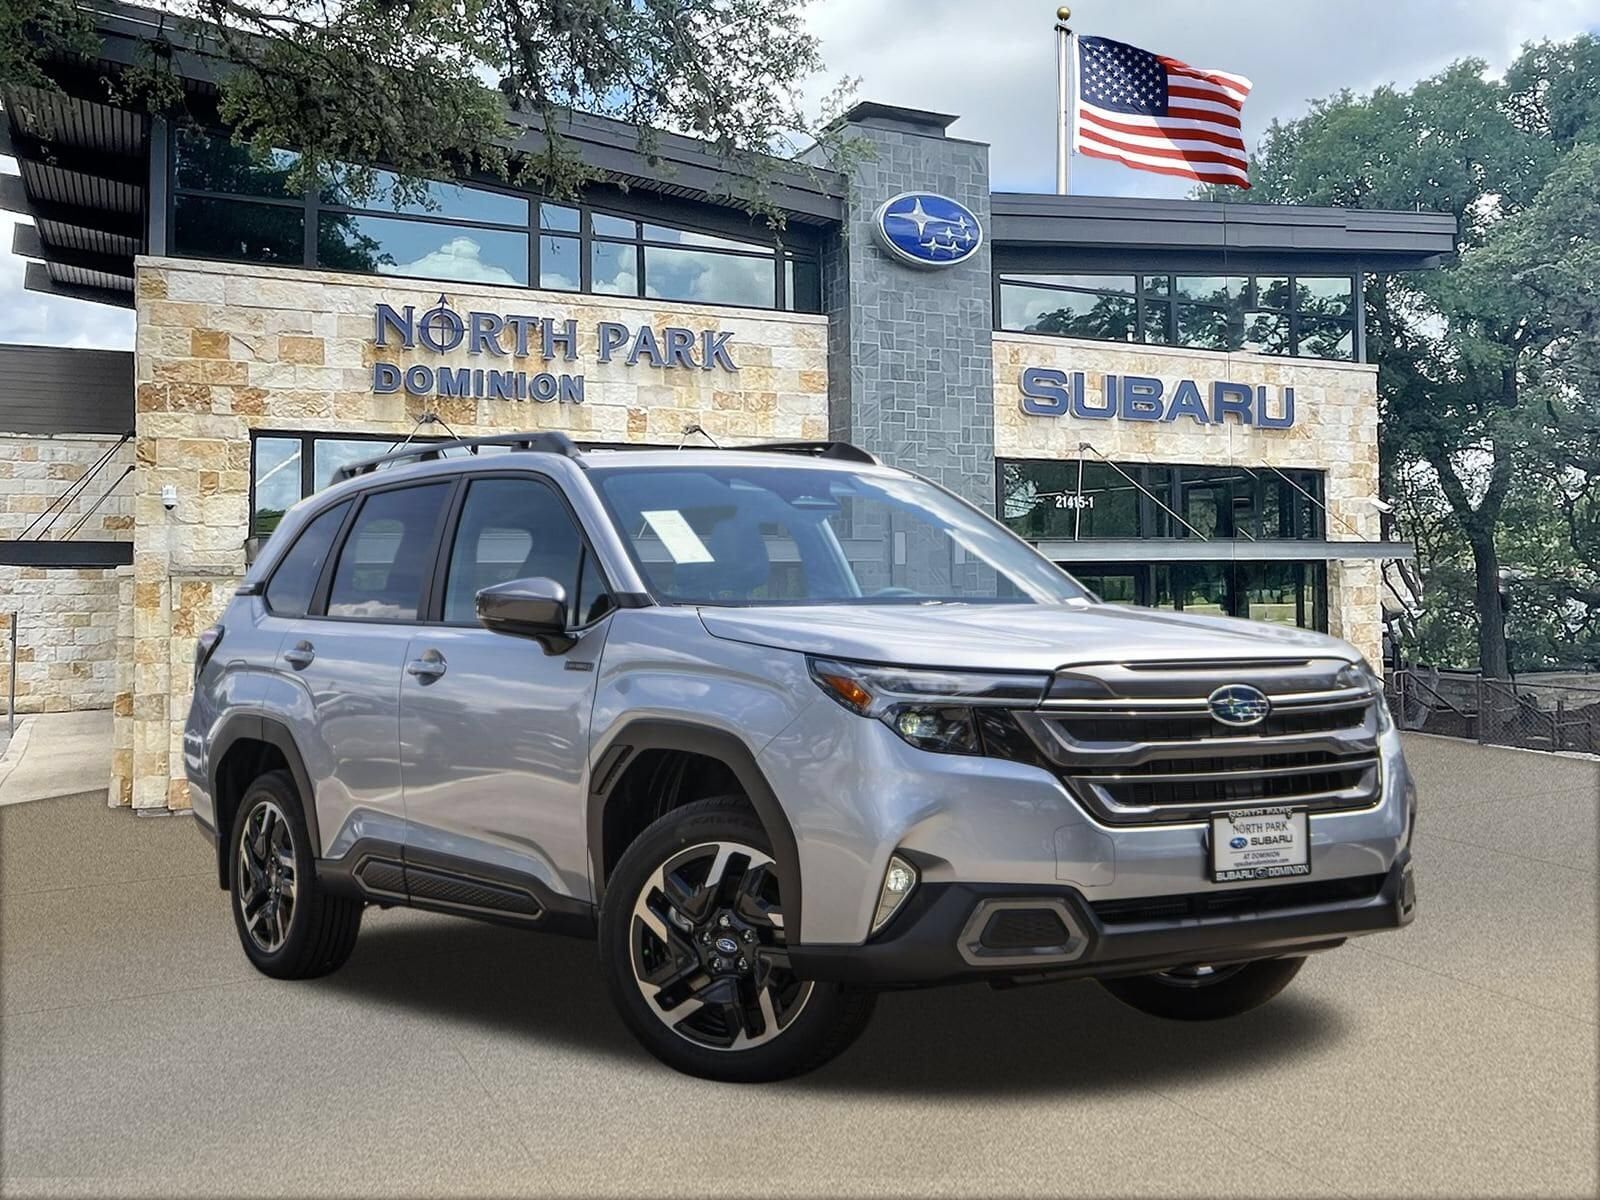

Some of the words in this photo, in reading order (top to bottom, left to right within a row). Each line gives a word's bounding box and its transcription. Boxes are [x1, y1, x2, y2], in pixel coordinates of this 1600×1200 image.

[374, 300, 579, 361] NORTH
[597, 321, 741, 373] PARK
[373, 362, 585, 405] DOMINION
[1019, 366, 1295, 430] SUBARU
[1055, 495, 1094, 509] 21415-1
[1233, 823, 1263, 835] NORTH
[1265, 821, 1289, 833] PARK
[1250, 834, 1293, 846] SUBARU
[1216, 869, 1254, 881] SUBARU
[1268, 864, 1309, 877] DOMINION
